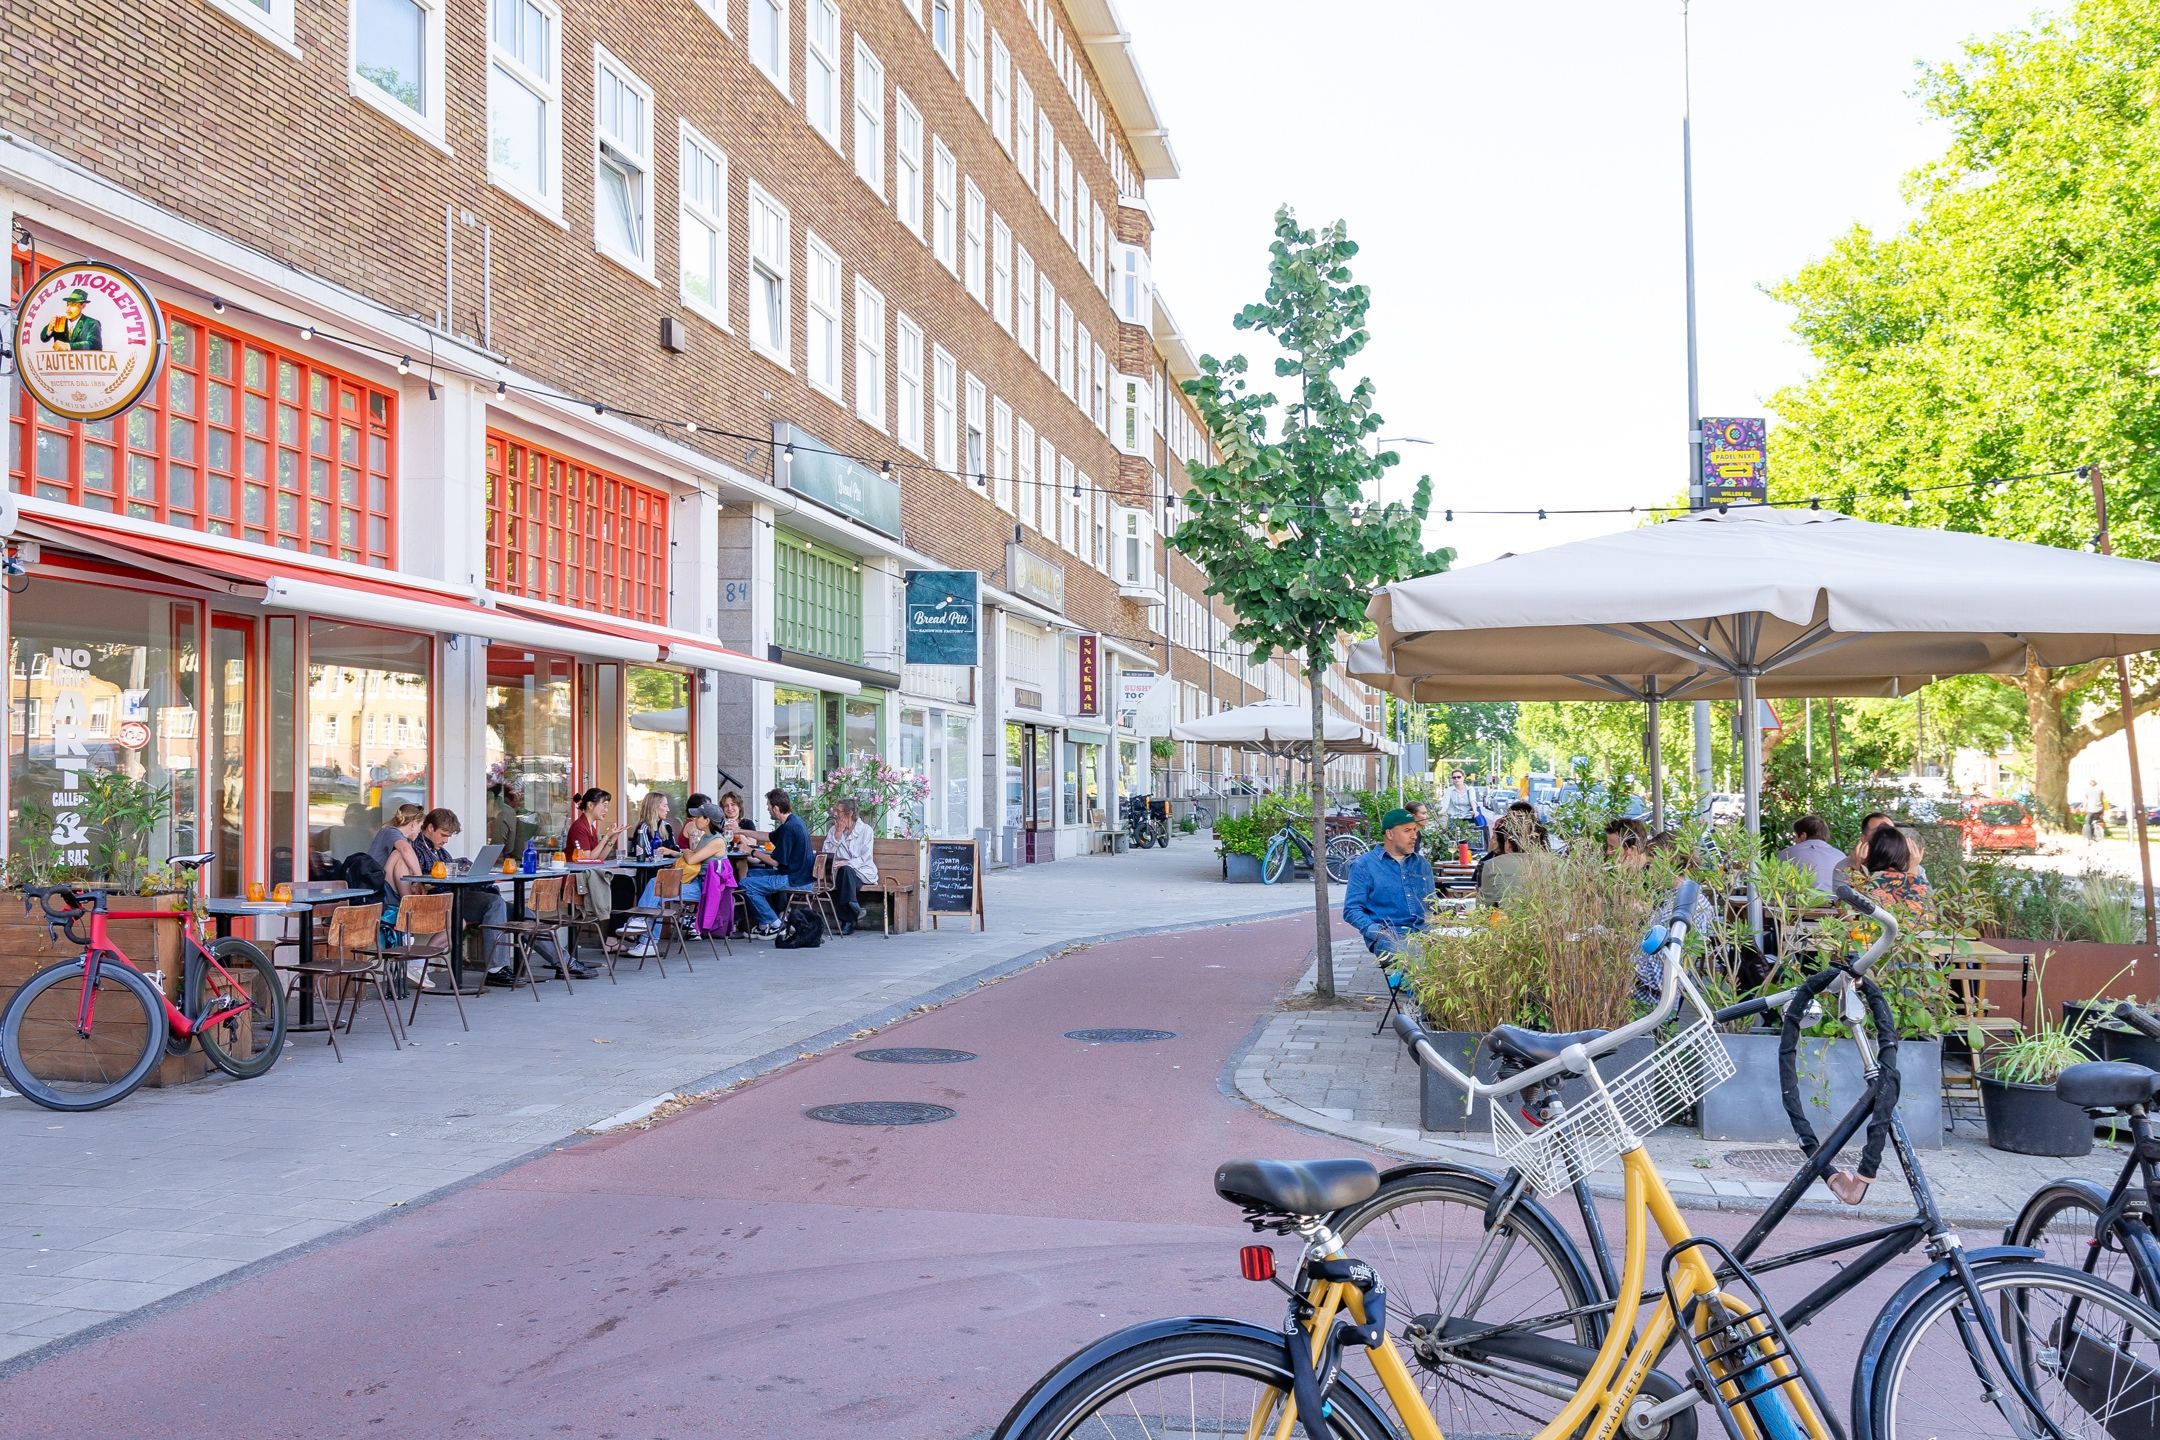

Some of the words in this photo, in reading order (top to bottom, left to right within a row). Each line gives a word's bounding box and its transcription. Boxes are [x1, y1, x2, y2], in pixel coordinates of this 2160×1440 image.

[22, 279, 67, 346] BIRRA
[71, 273, 147, 346] MORETTI
[36, 353, 118, 371] L'AUTENTICA
[726, 582, 746, 602] 84
[913, 610, 947, 625] Bread
[948, 611, 969, 626] Pitt
[53, 647, 91, 668] NO
[1083, 638, 1093, 711] SNACKBAR
[52, 691, 90, 790] ART
[52, 792, 89, 807] GALLER
[1598, 1370, 1642, 1440] SWAPFIETS
